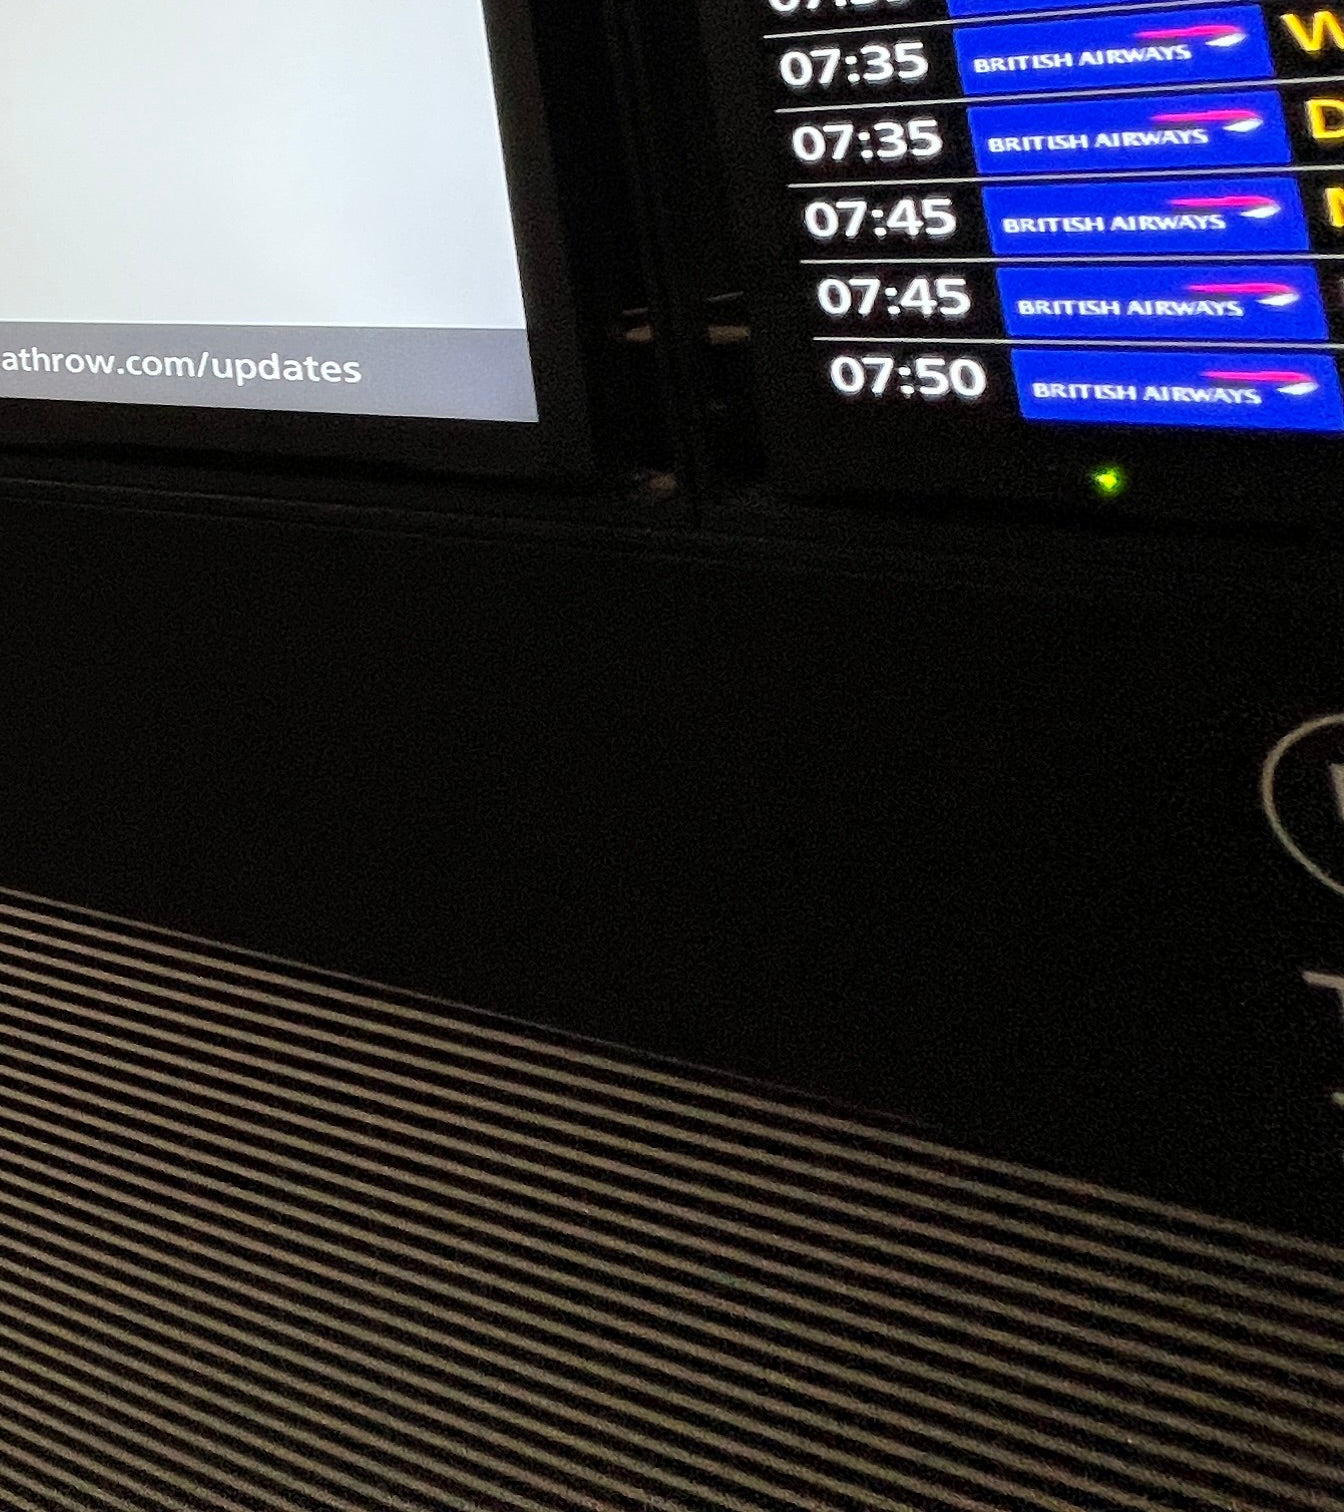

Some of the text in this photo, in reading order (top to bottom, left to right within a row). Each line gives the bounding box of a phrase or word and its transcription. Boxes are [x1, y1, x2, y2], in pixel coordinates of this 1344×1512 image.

[780, 41, 928, 87] 07:35
[974, 53, 1072, 72] BRITISH
[1079, 45, 1191, 66] AIRWAYS
[792, 118, 942, 161] 07:35
[988, 135, 1088, 152] BRITISH
[1095, 129, 1208, 147] AIRWAYS
[804, 199, 1225, 238] 07:45 BRITISH AIRWAYS
[818, 277, 1243, 317] 07:45 BRITISH AIRWAYS
[831, 355, 1261, 404] 07:50 BRITISH AIRWAYS
